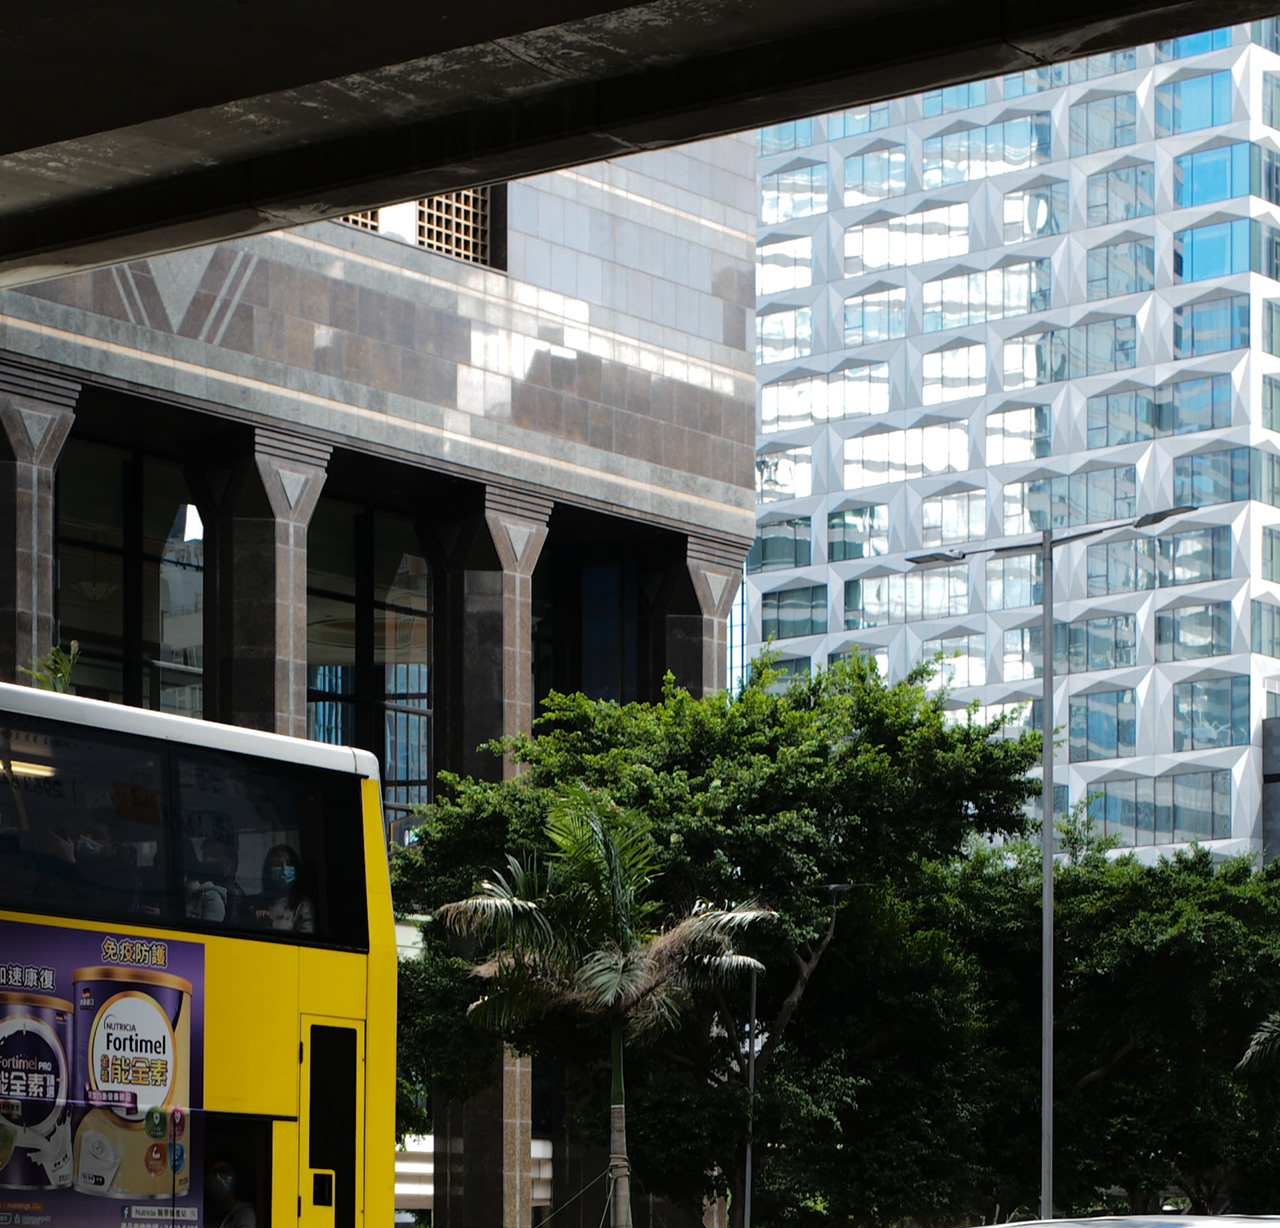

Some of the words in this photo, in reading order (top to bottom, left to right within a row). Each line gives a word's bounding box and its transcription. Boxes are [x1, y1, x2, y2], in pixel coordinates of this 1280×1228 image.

[102, 937, 168, 967] 免疫防護
[106, 1022, 136, 1032] NUTRICIA
[106, 1033, 166, 1055] Fortimel
[38, 1061, 52, 1071] PRO
[111, 1055, 168, 1086] 能全素
[135, 1208, 156, 1217] Nutricia
